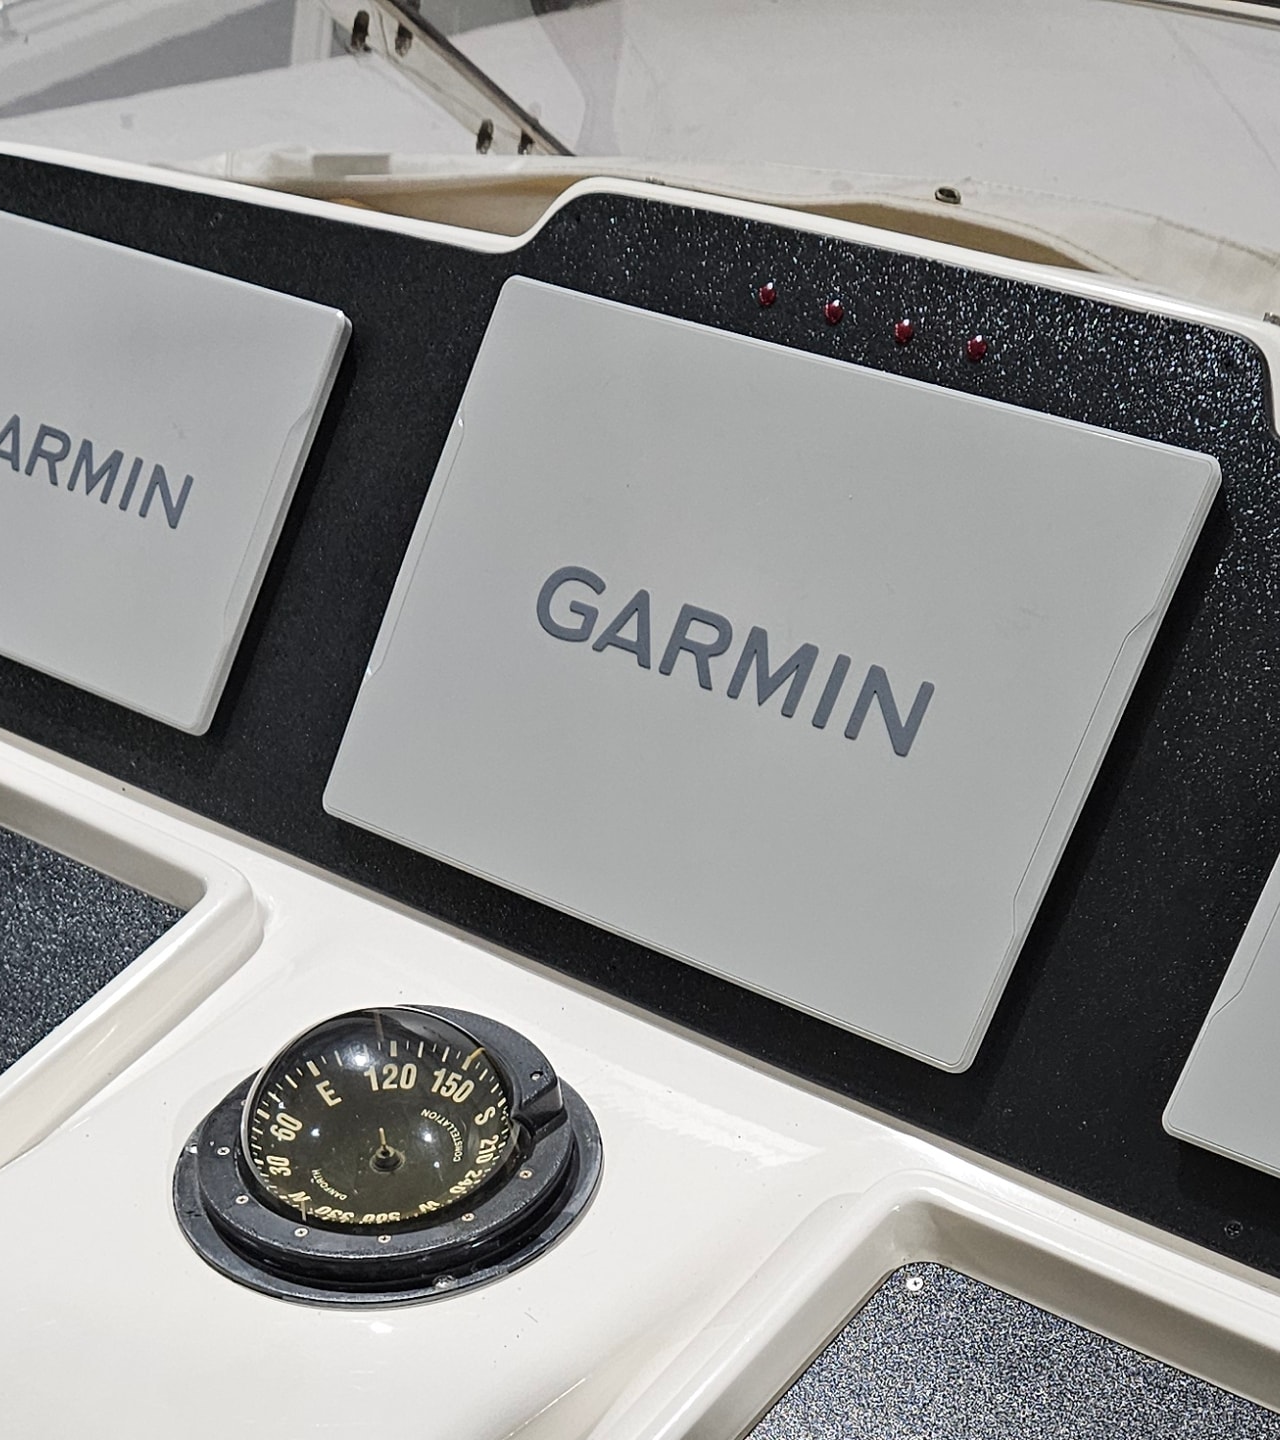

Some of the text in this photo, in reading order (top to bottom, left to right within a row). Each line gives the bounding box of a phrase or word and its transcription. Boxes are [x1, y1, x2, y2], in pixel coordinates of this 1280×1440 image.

[535, 565, 936, 758] GARMIN
[364, 1062, 417, 1091] 120
[430, 1067, 475, 1103] 150
[315, 1079, 343, 1106] E
[270, 1112, 303, 1141] 60
[474, 1106, 496, 1126] S
[420, 1107, 463, 1163] CONSTELLATION
[476, 1134, 500, 1165] 210
[266, 1155, 292, 1177] 30
